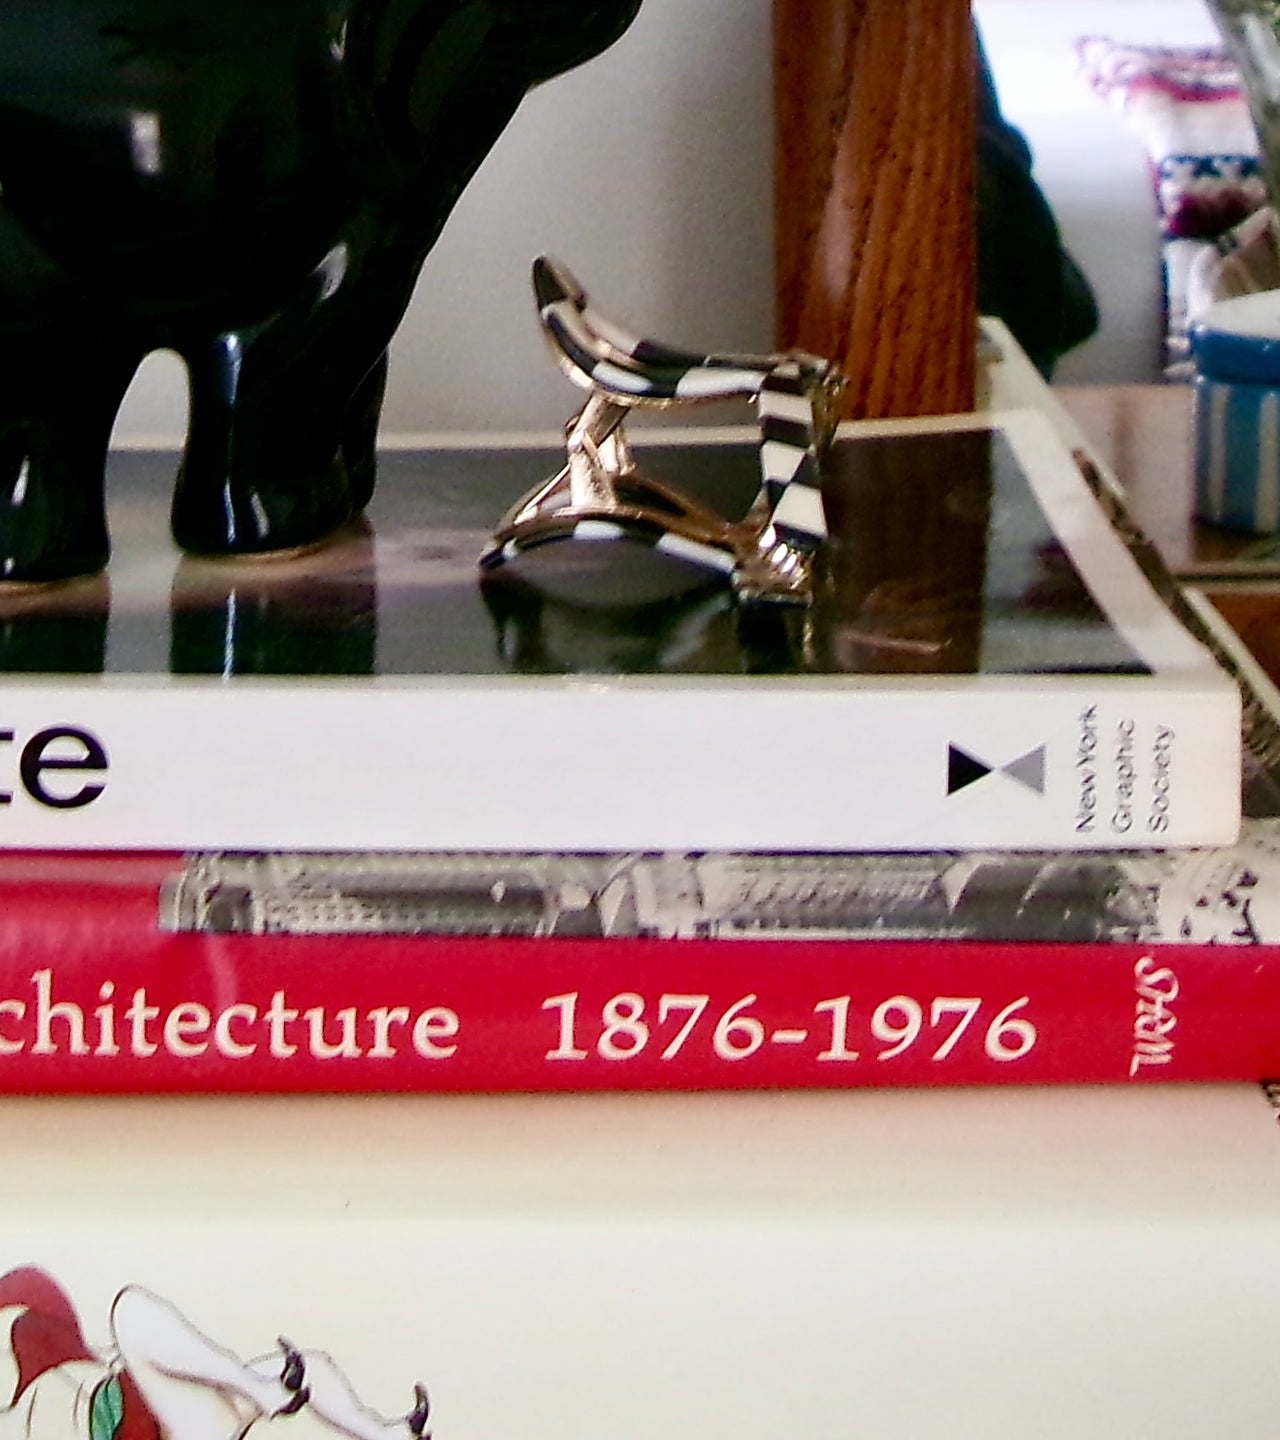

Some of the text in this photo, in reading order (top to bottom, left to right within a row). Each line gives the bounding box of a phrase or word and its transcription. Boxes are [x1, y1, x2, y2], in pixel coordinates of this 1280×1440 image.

[1108, 718, 1137, 834] Graphic
[1146, 724, 1176, 834] Society
[540, 992, 1039, 1063] 1876-1976
